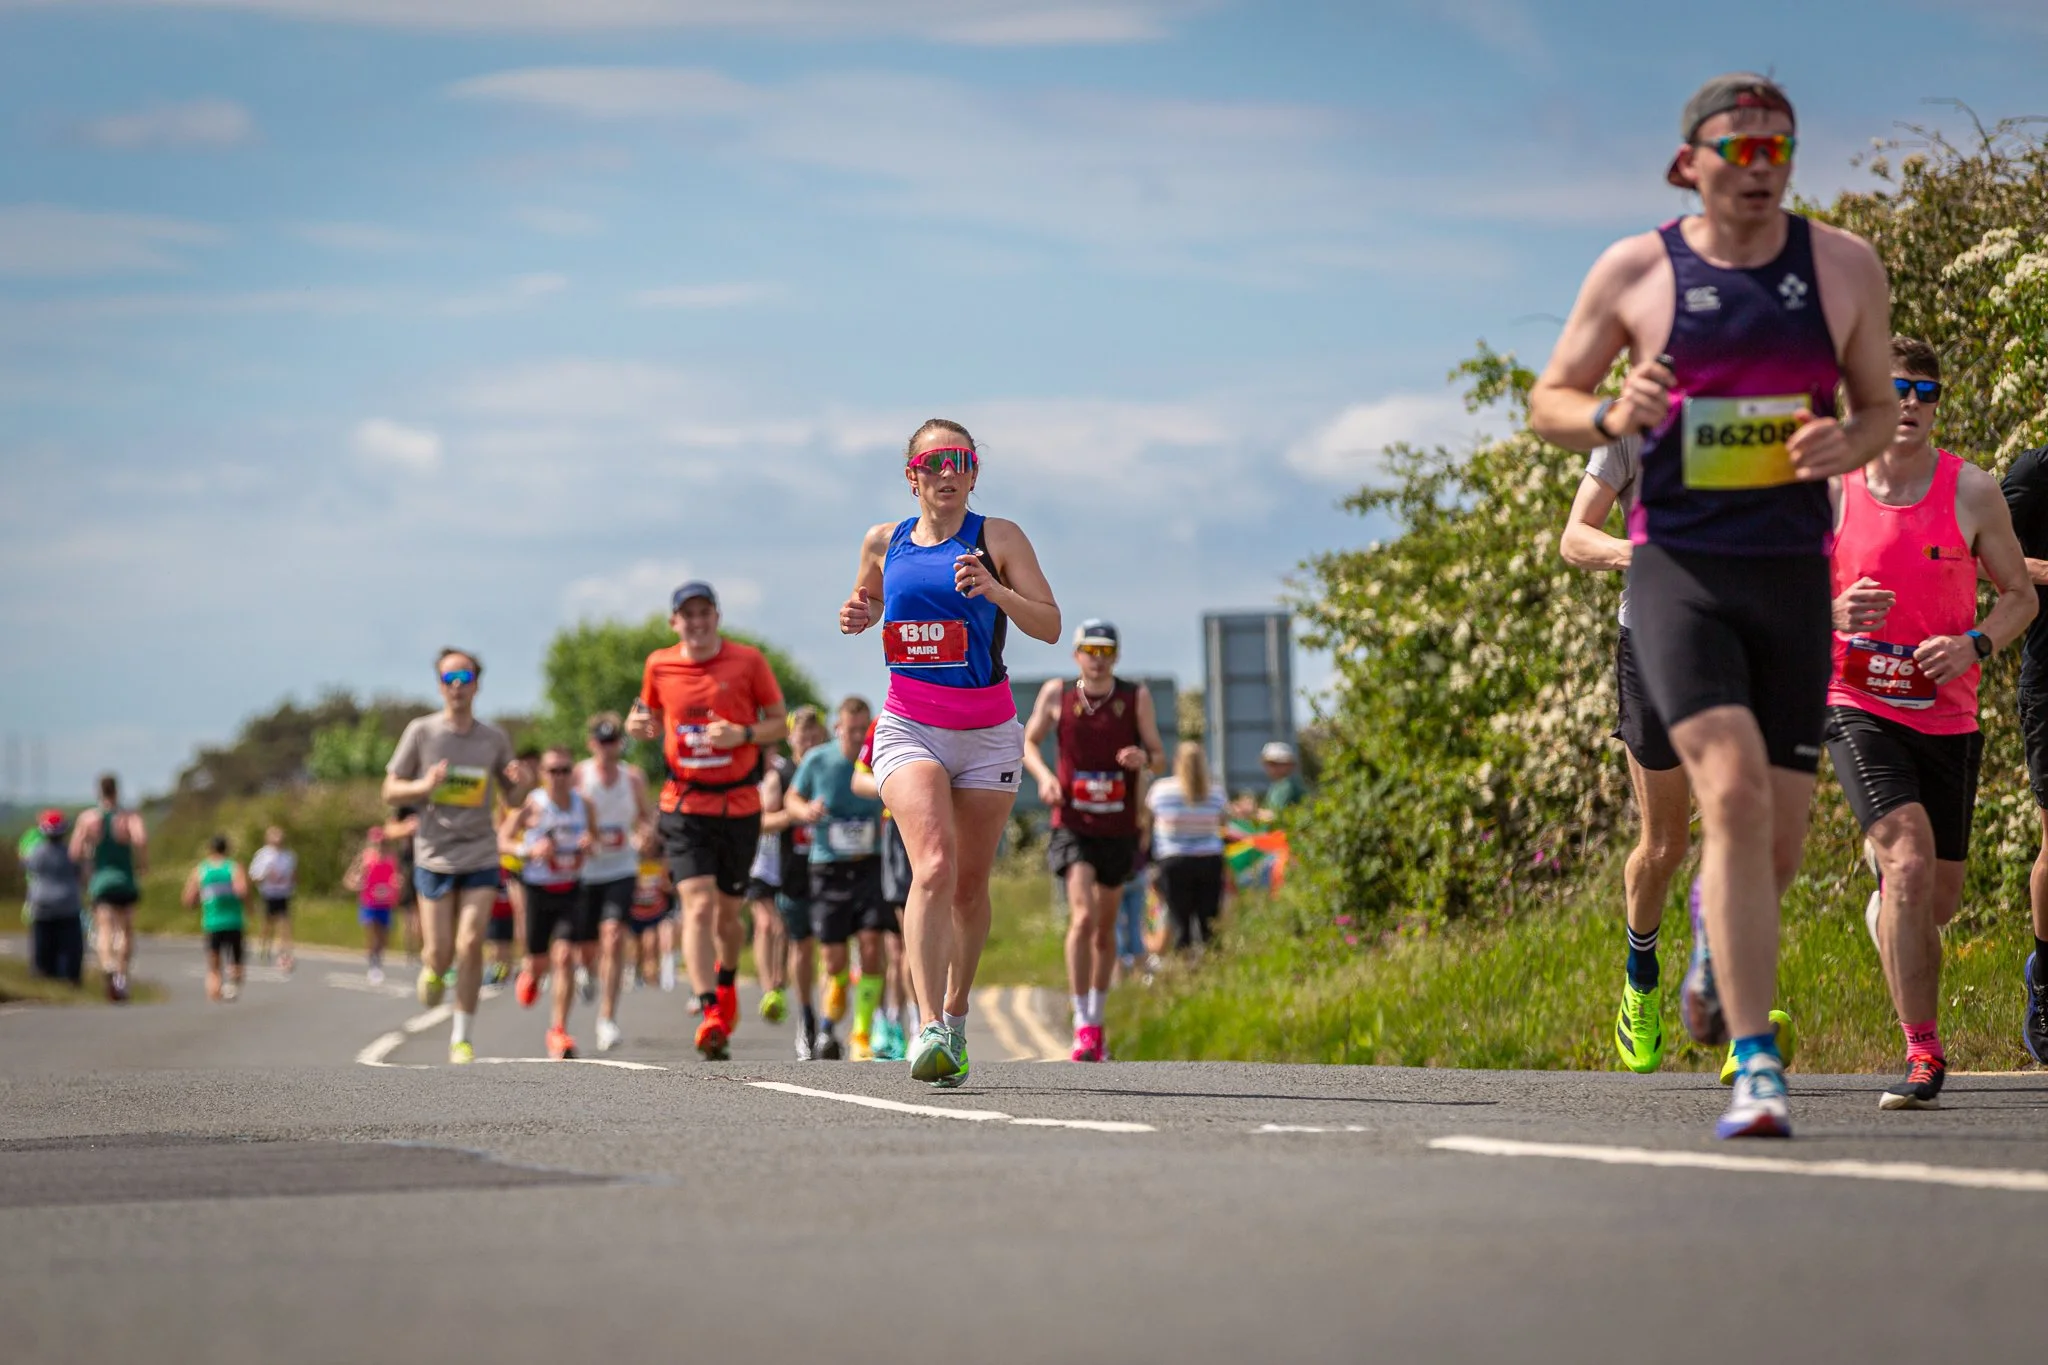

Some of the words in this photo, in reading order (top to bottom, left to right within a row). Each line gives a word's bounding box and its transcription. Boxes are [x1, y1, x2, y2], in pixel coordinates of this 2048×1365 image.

[899, 623, 945, 642] 1310
[907, 645, 938, 655] MAIRI
[1868, 655, 1915, 676] 876
[1866, 676, 1912, 690] SAMUEL
